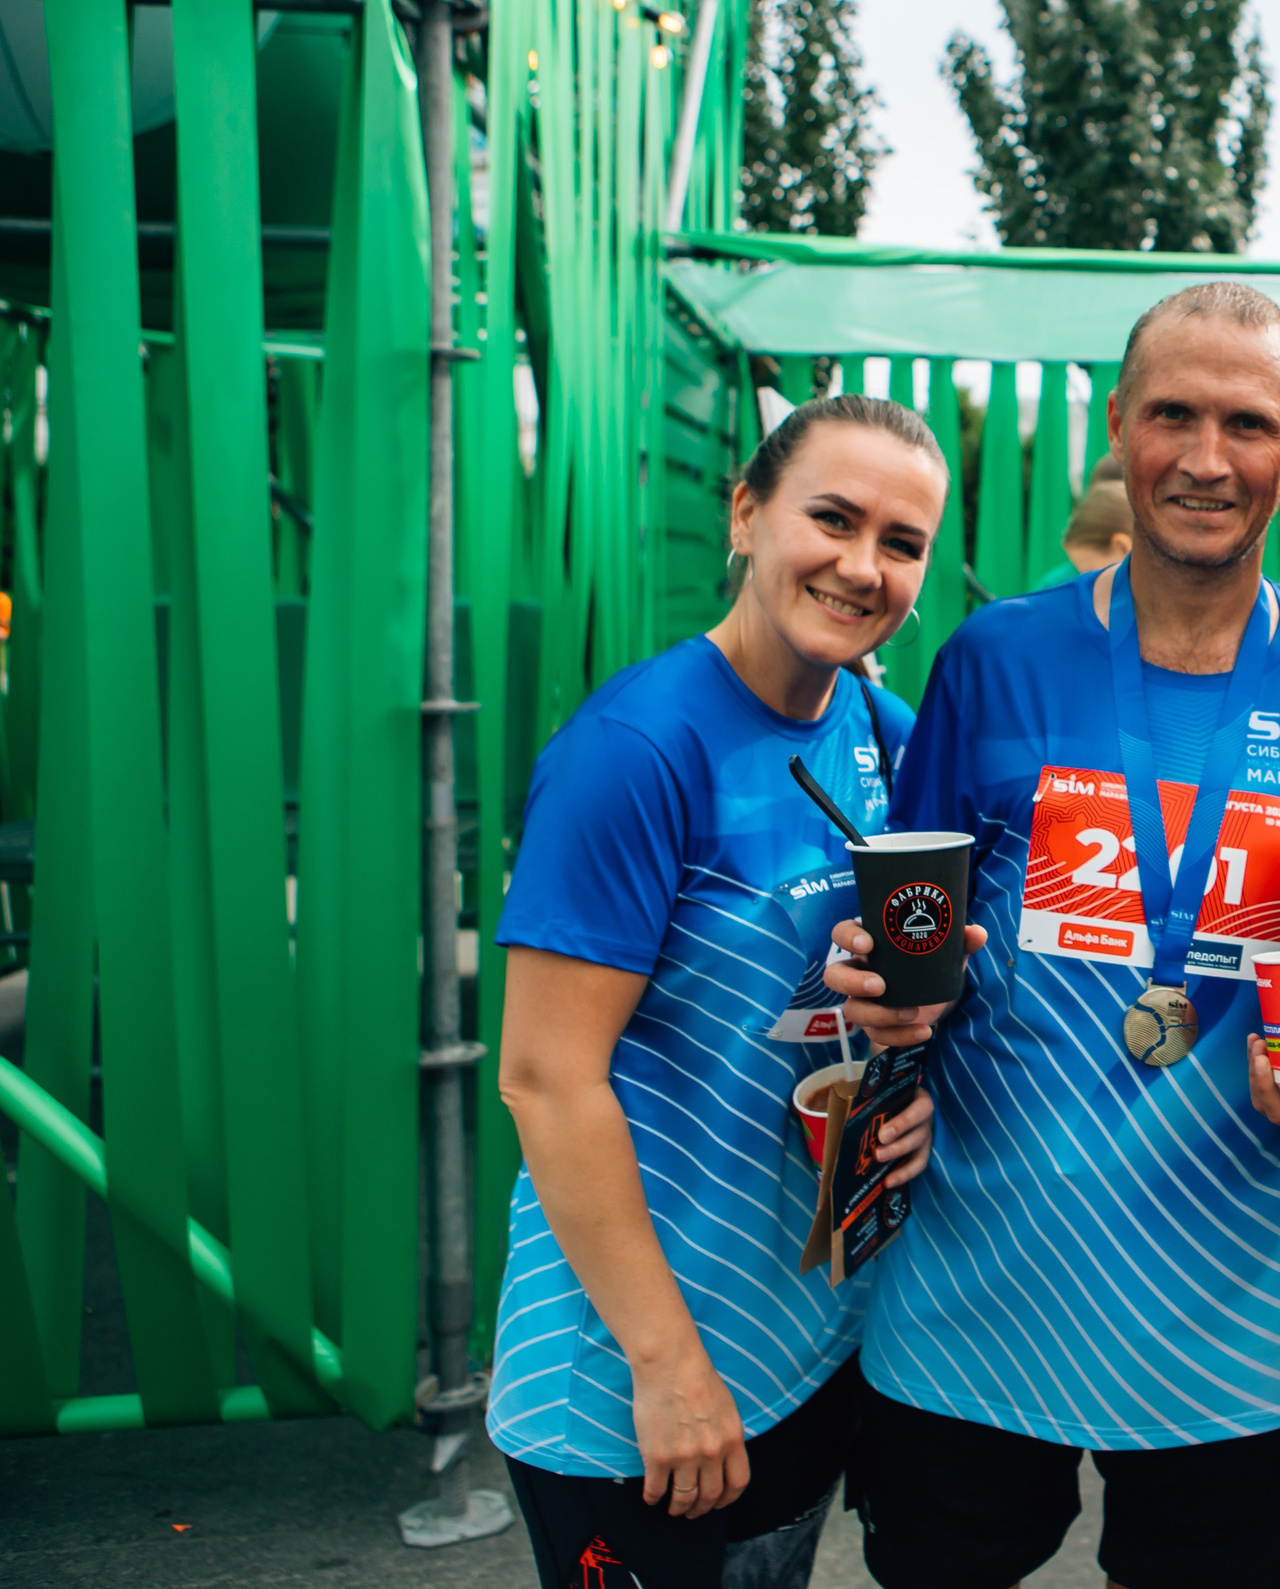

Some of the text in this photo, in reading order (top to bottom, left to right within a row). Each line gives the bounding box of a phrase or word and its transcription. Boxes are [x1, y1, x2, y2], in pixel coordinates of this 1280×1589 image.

[891, 885, 945, 907] ФАБРИКА
[1063, 929, 1128, 948] Альфа Банк
[1186, 951, 1238, 965] ледопыт
